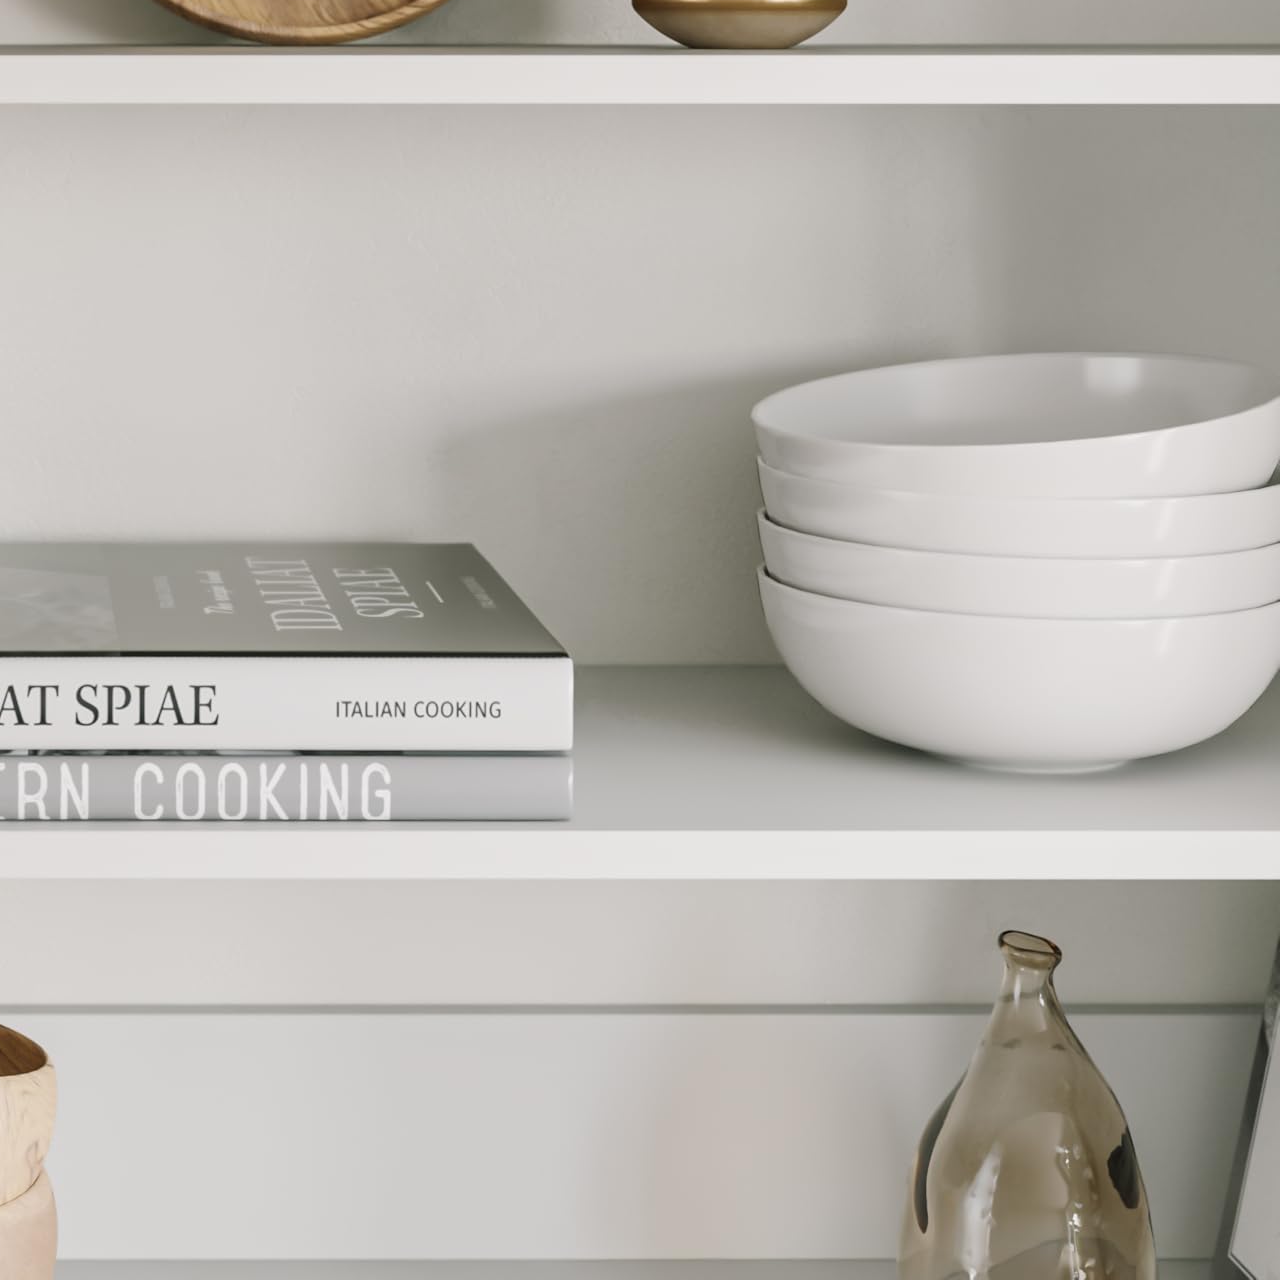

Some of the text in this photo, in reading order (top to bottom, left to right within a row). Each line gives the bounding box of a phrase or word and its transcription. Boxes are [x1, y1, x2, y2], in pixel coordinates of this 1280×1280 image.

[244, 556, 344, 632] IDALIAT
[333, 567, 425, 619] SPIAE
[74, 683, 220, 727] SPIAE
[335, 700, 503, 719] ITALIAN COOKING
[132, 761, 392, 821] COOKING
